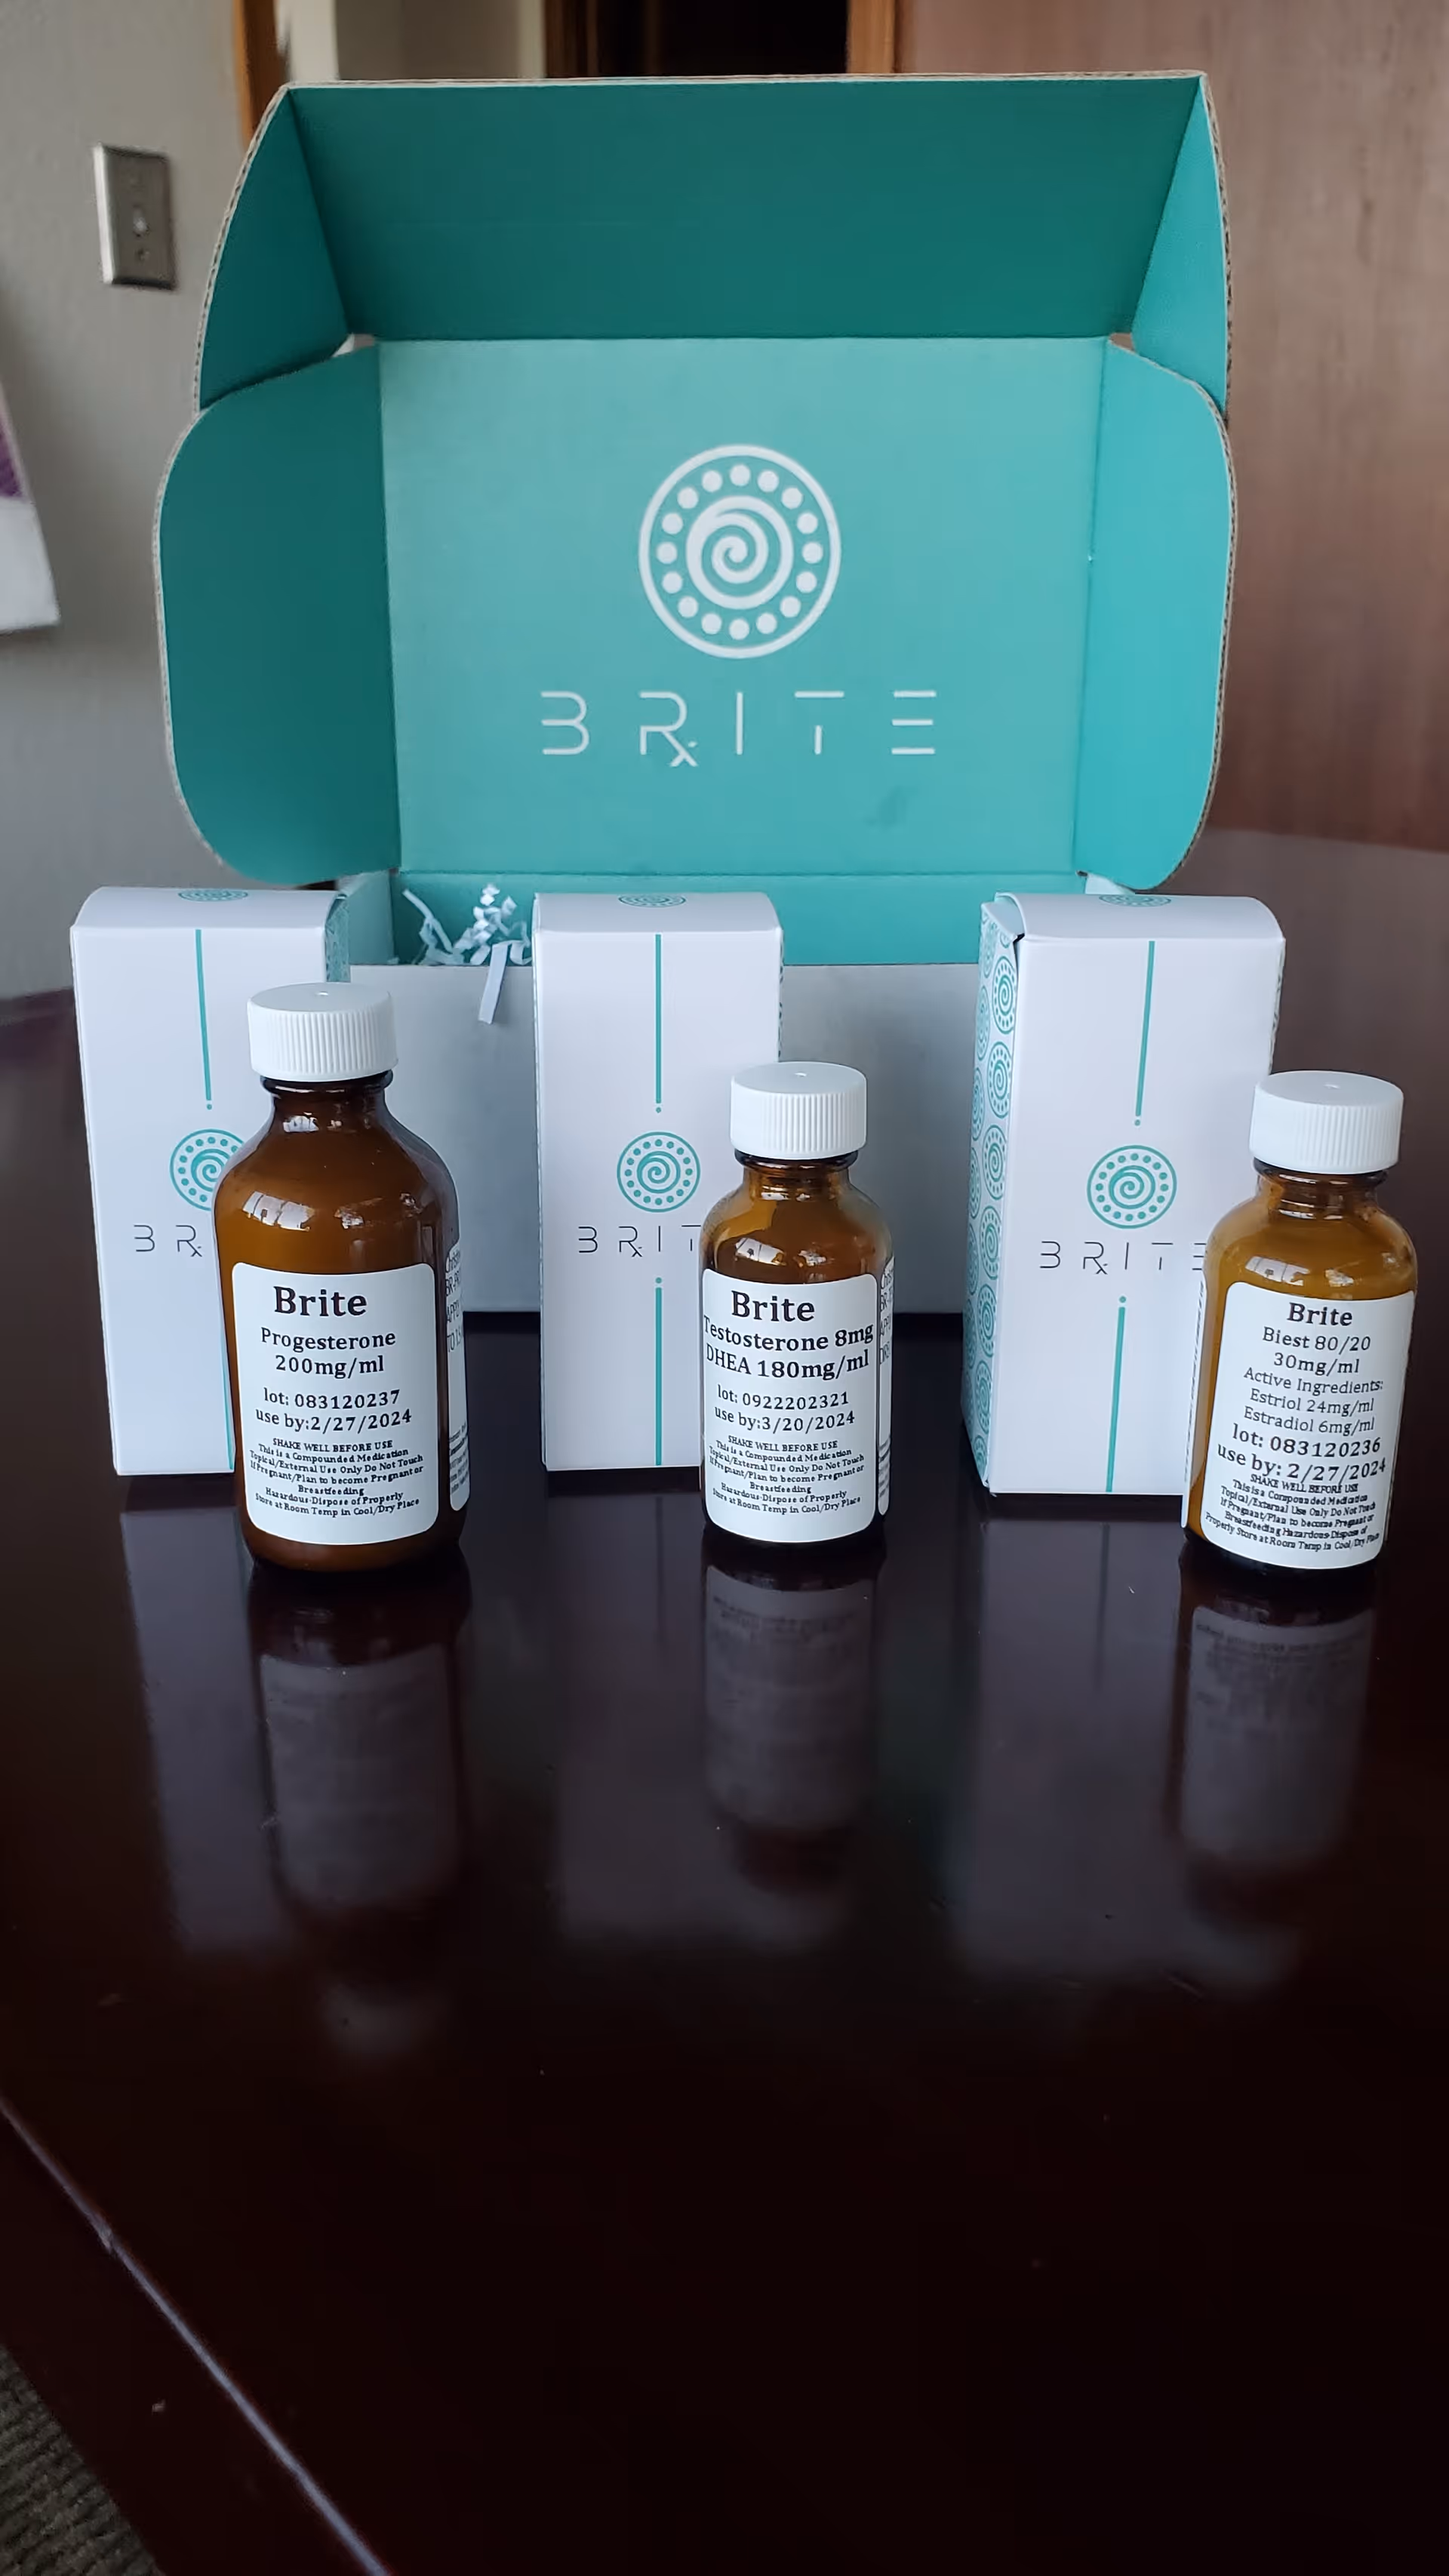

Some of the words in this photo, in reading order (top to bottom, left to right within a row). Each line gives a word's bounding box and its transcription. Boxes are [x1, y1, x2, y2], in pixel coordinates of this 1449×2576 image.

[578, 1223, 702, 1257] BRIT
[273, 1286, 367, 1316] Brite
[731, 1290, 815, 1322] Brite
[1287, 1302, 1352, 1326] Brite
[261, 1327, 395, 1353] Progesterone
[703, 1315, 829, 1351] Testosterone
[835, 1324, 874, 1346] 8mg
[1263, 1326, 1310, 1348] Biest
[1315, 1335, 1371, 1355] 80/20
[275, 1355, 384, 1379] 200mg/ml
[706, 1343, 752, 1374] DHEA
[758, 1349, 869, 1380] 180mg/ml
[1274, 1352, 1359, 1376] 30mg/ml
[1244, 1367, 1291, 1389] Active
[1297, 1378, 1383, 1396] Ingredients:
[263, 1387, 289, 1405] lot:
[295, 1389, 400, 1409] 083120237
[718, 1383, 738, 1403] lot:
[743, 1391, 849, 1410] 0922202321
[1250, 1388, 1301, 1411] Estriol
[1306, 1398, 1374, 1417] 24mg/ml
[256, 1409, 280, 1425] use
[715, 1406, 734, 1423] use
[1244, 1405, 1313, 1432] Estradiol
[1318, 1417, 1374, 1436] 6mg/ml
[272, 1438, 301, 1450] SHAKE
[303, 1442, 331, 1452] WELL
[332, 1443, 372, 1452] BEFORE
[374, 1440, 393, 1450] USE
[715, 1439, 729, 1451] This
[745, 1450, 803, 1462] Compounded
[804, 1449, 852, 1462] Medication
[728, 1435, 753, 1448] SHAKE
[755, 1441, 780, 1451] WELL
[782, 1443, 819, 1452] BEFORE
[821, 1440, 838, 1450] USE
[1232, 1423, 1263, 1448] lot:
[1270, 1436, 1381, 1457] 083120236
[250, 1450, 318, 1473] Topical/External
[319, 1465, 337, 1473] Use
[340, 1466, 362, 1476] Only
[364, 1464, 377, 1473] Do
[379, 1462, 396, 1471] Not
[398, 1454, 423, 1467] Touch
[258, 1443, 273, 1455] This
[276, 1449, 283, 1457] is
[293, 1452, 355, 1464] Compounded
[357, 1449, 408, 1462] Medication
[789, 1464, 810, 1474] Only
[811, 1463, 823, 1472] Do
[825, 1461, 841, 1470] Not
[842, 1454, 864, 1467] Touch
[1217, 1444, 1246, 1465] use
[1251, 1453, 1281, 1477] by:
[1287, 1457, 1386, 1484] 2/27/2024
[257, 1463, 317, 1483] Pregnant/Plan
[371, 1469, 413, 1482] Pregnant
[414, 1466, 423, 1474] or
[817, 1467, 855, 1481] Pregnant
[1250, 1473, 1279, 1488] SHAKE
[1281, 1480, 1306, 1492] WELL
[1308, 1484, 1343, 1494] BEFORE
[298, 1484, 364, 1496] Breastfeeding
[351, 1497, 361, 1505] of
[362, 1492, 404, 1504] Properly
[749, 1481, 812, 1494] Breastfeeding
[799, 1494, 808, 1503] of
[810, 1490, 847, 1503] Properly
[1232, 1479, 1251, 1492] This
[1251, 1485, 1260, 1495] is
[1268, 1490, 1326, 1505] Compounded
[255, 1492, 272, 1506] Store
[284, 1502, 309, 1514] Room
[311, 1507, 338, 1518] Temp
[353, 1505, 395, 1516] Cool/Dry
[397, 1498, 420, 1510] Place
[737, 1498, 761, 1511] Room
[761, 1503, 787, 1515] Temp
[801, 1503, 840, 1513] Cool/Dry
[841, 1497, 860, 1507] Place
[1220, 1497, 1227, 1507] If
[1291, 1506, 1306, 1516] Use
[1309, 1508, 1328, 1519] Only
[1331, 1508, 1342, 1516] Do
[1343, 1507, 1357, 1516] Not
[1205, 1511, 1235, 1534] Properly
[1236, 1527, 1257, 1540] Store
[1269, 1536, 1296, 1548] Room
[1298, 1540, 1321, 1552] Temp
[1225, 1510, 1281, 1537] Breastfeeding
